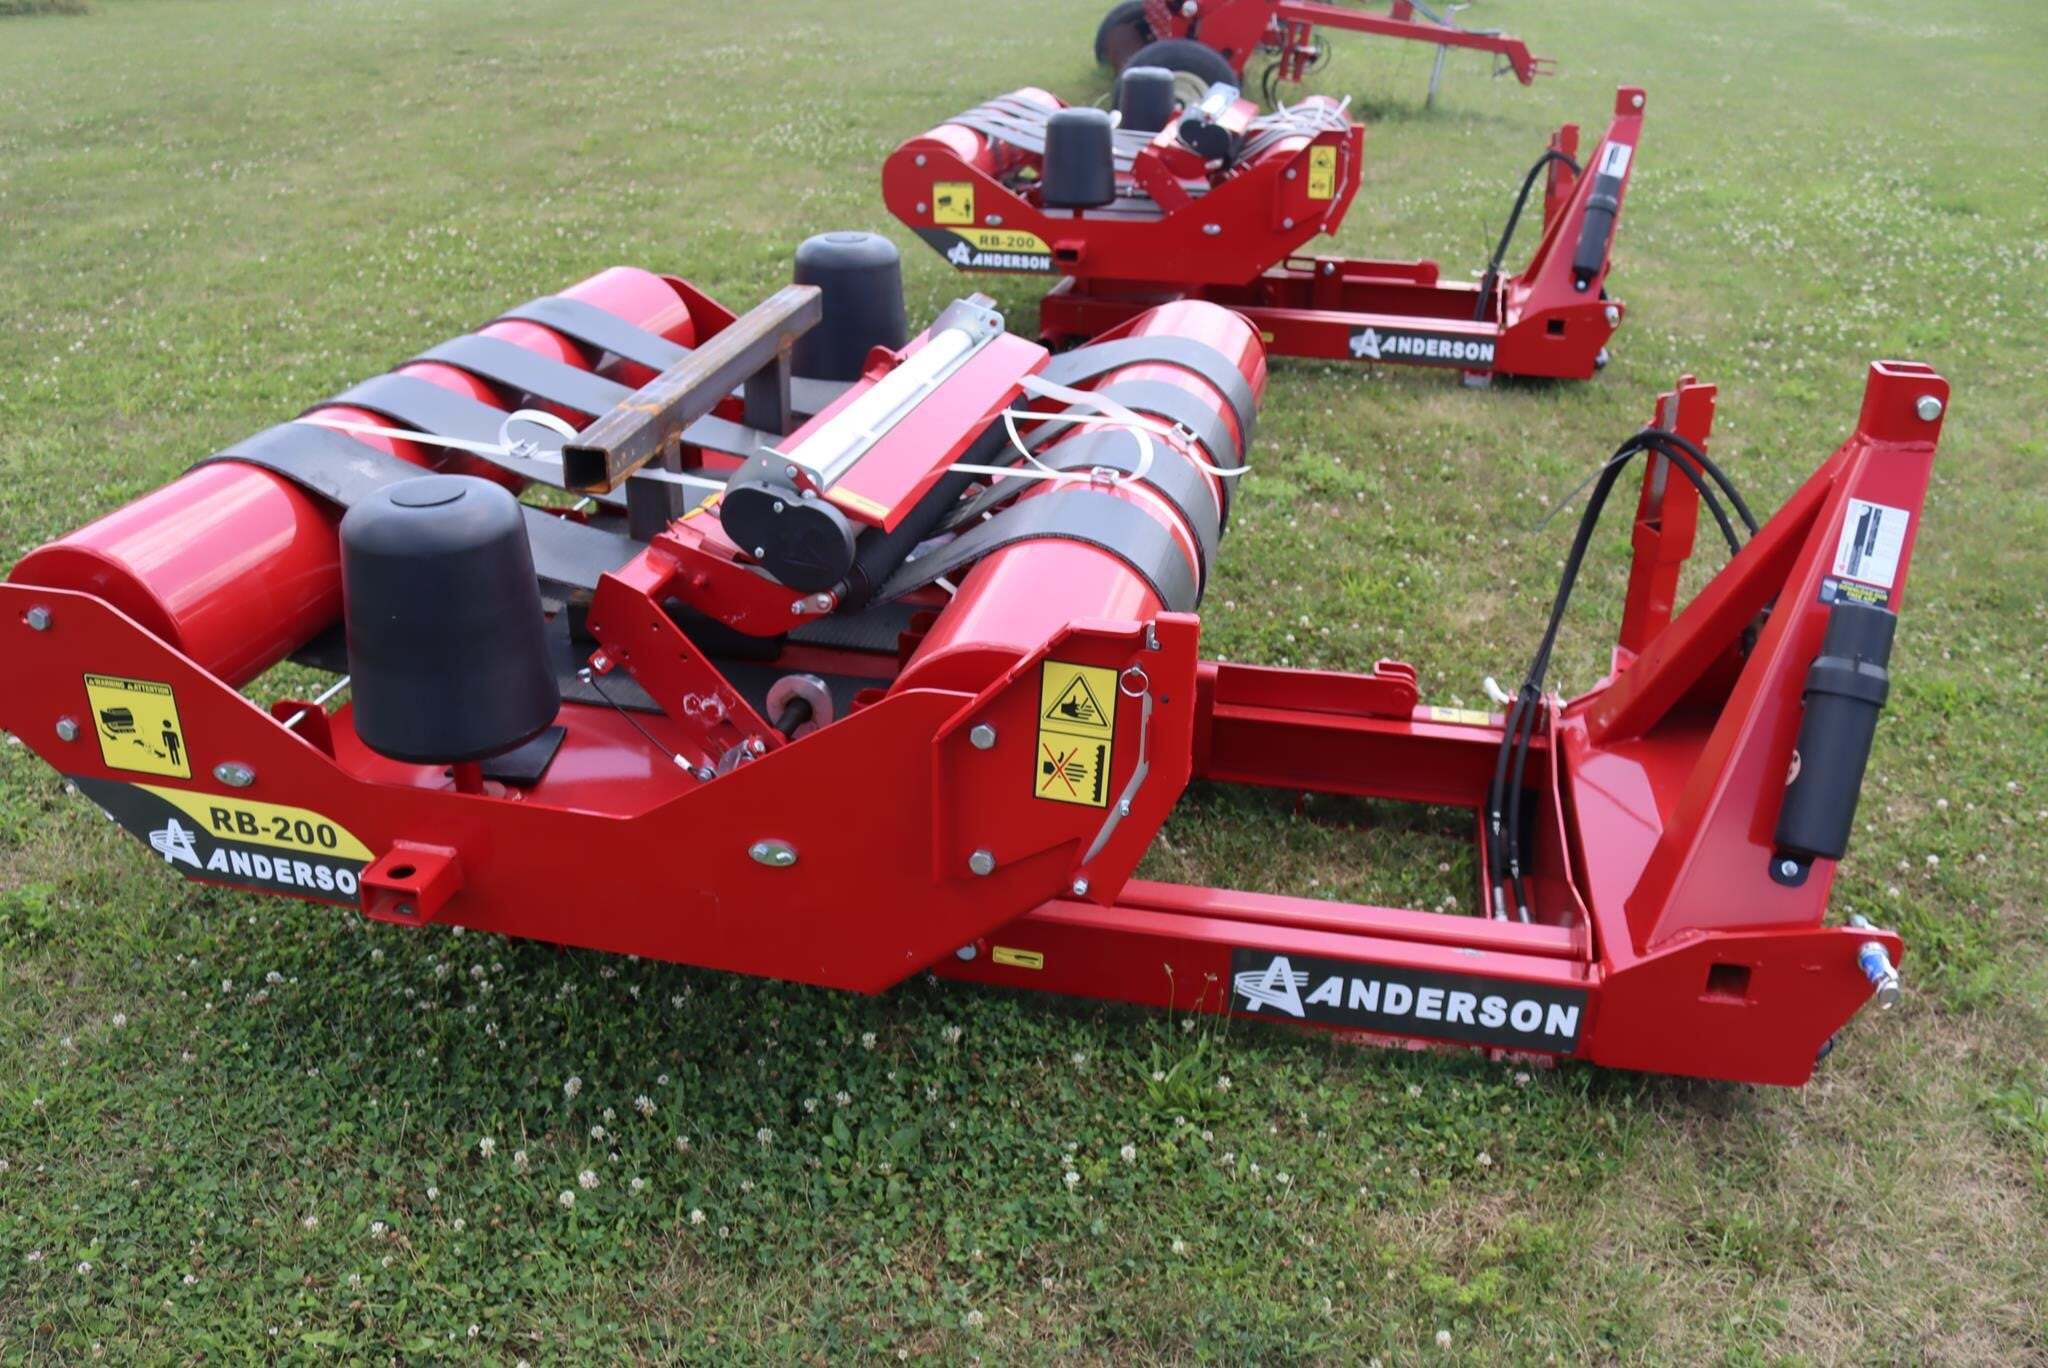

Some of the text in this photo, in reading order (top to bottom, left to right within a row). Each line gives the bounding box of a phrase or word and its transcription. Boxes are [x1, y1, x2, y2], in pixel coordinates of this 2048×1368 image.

[979, 235, 1035, 248] RB-200
[972, 253, 1051, 270] ANDERSON
[1379, 335, 1495, 362] ANDERSON
[209, 806, 338, 849] RB-200
[206, 848, 363, 895] ANDERSO
[1305, 975, 1580, 1039] ANDERSON
